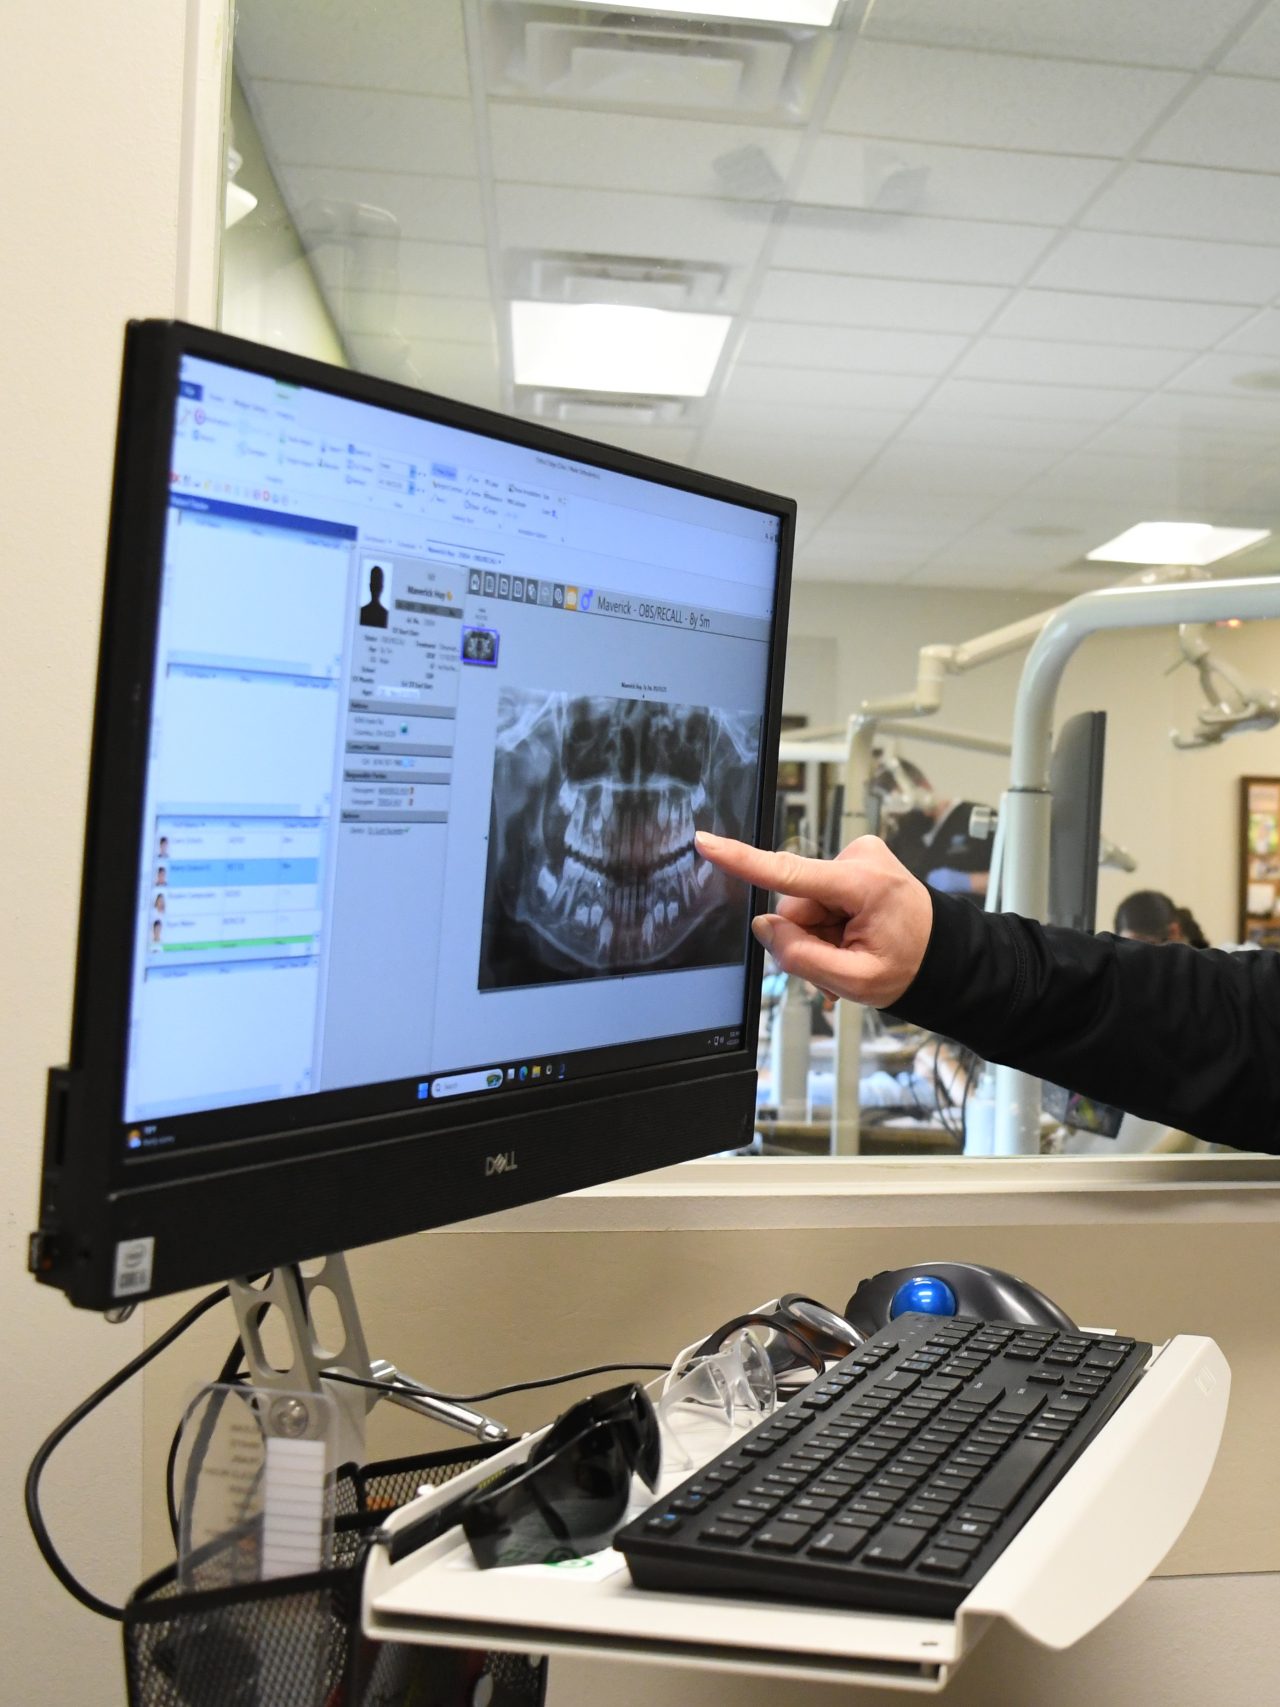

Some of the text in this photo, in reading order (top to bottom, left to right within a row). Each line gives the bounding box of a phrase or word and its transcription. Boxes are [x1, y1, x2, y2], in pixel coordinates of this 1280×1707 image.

[598, 596, 631, 615] Maverick
[639, 603, 683, 624] OBS/RECALL
[700, 613, 710, 629] 5m
[485, 1151, 518, 1176] DELL
